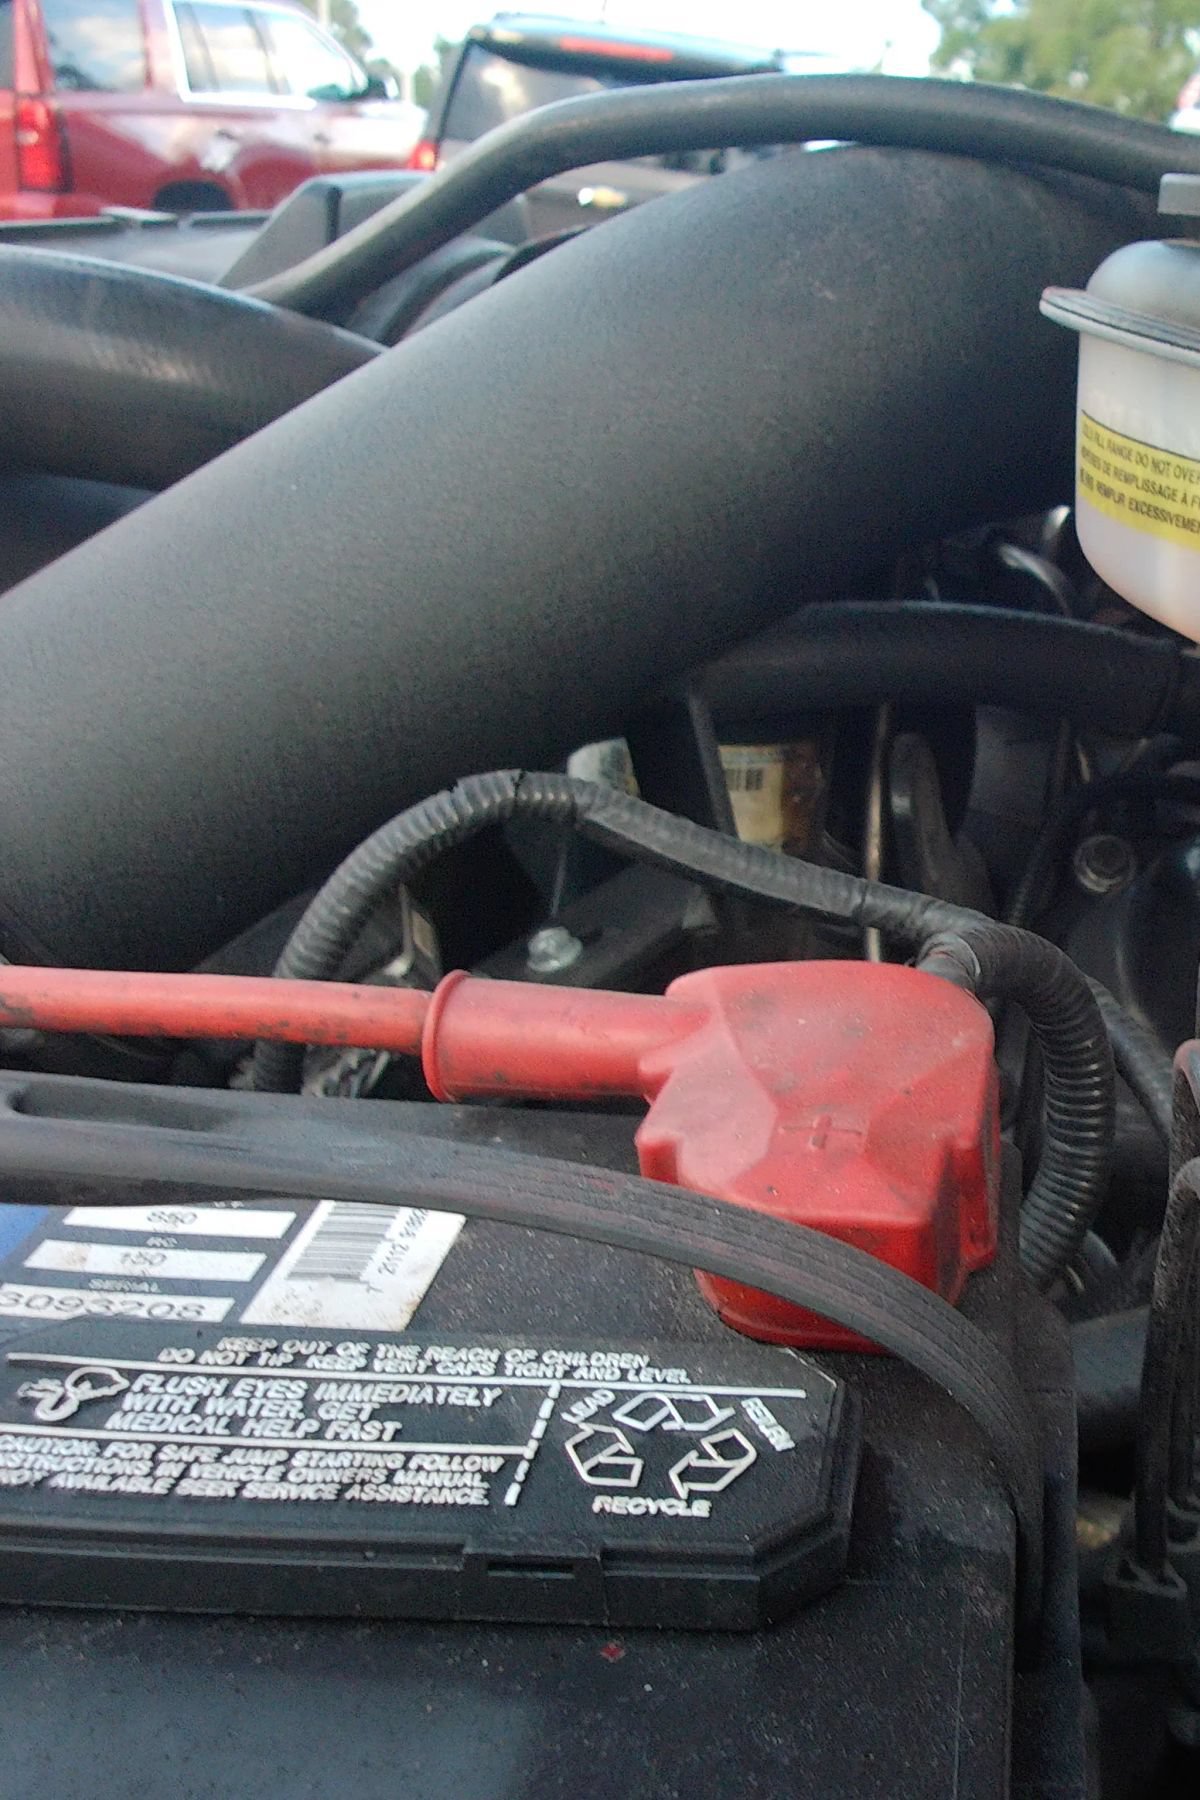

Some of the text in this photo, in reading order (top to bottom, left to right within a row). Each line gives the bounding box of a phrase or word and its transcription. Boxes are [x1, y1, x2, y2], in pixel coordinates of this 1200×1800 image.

[1107, 440, 1132, 462] RANGE
[1135, 450, 1149, 468] DO
[1151, 456, 1171, 477] NOT
[1096, 480, 1125, 505] REMPLIR
[1113, 465, 1178, 503] REMPLISSAGE
[157, 1347, 196, 1364] DO
[199, 1350, 251, 1366] NOT
[306, 1354, 368, 1371] KEEP
[373, 1357, 431, 1374] VENT
[436, 1361, 496, 1376] CAPS
[504, 1362, 570, 1379] TIGHT
[573, 1365, 622, 1381] AND
[627, 1367, 692, 1384] LEVEL
[217, 1336, 650, 1369] KEEP OUT OF THE REACH OF CHILDREN
[122, 1392, 381, 1422] WITH WATER. GET
[131, 1373, 502, 1407] FLUSH EYES IMMEDIATELY
[560, 1388, 617, 1425] LEAD
[104, 1410, 402, 1442] MEDICAL HELP FAST
[0, 1434, 505, 1474] AUTION: FOR SAFE JUMP STARTING FOLLOW
[49, 1472, 177, 1496] AVAILABLE
[174, 1479, 240, 1498] SEEK
[241, 1481, 341, 1500] SERVICE
[345, 1484, 491, 1506] ASSISTANCE.
[154, 1461, 187, 1478] IN
[189, 1463, 286, 1482] VEHICLE
[393, 1469, 491, 1489] MANUAL.
[592, 1495, 712, 1518] RECYCLE
